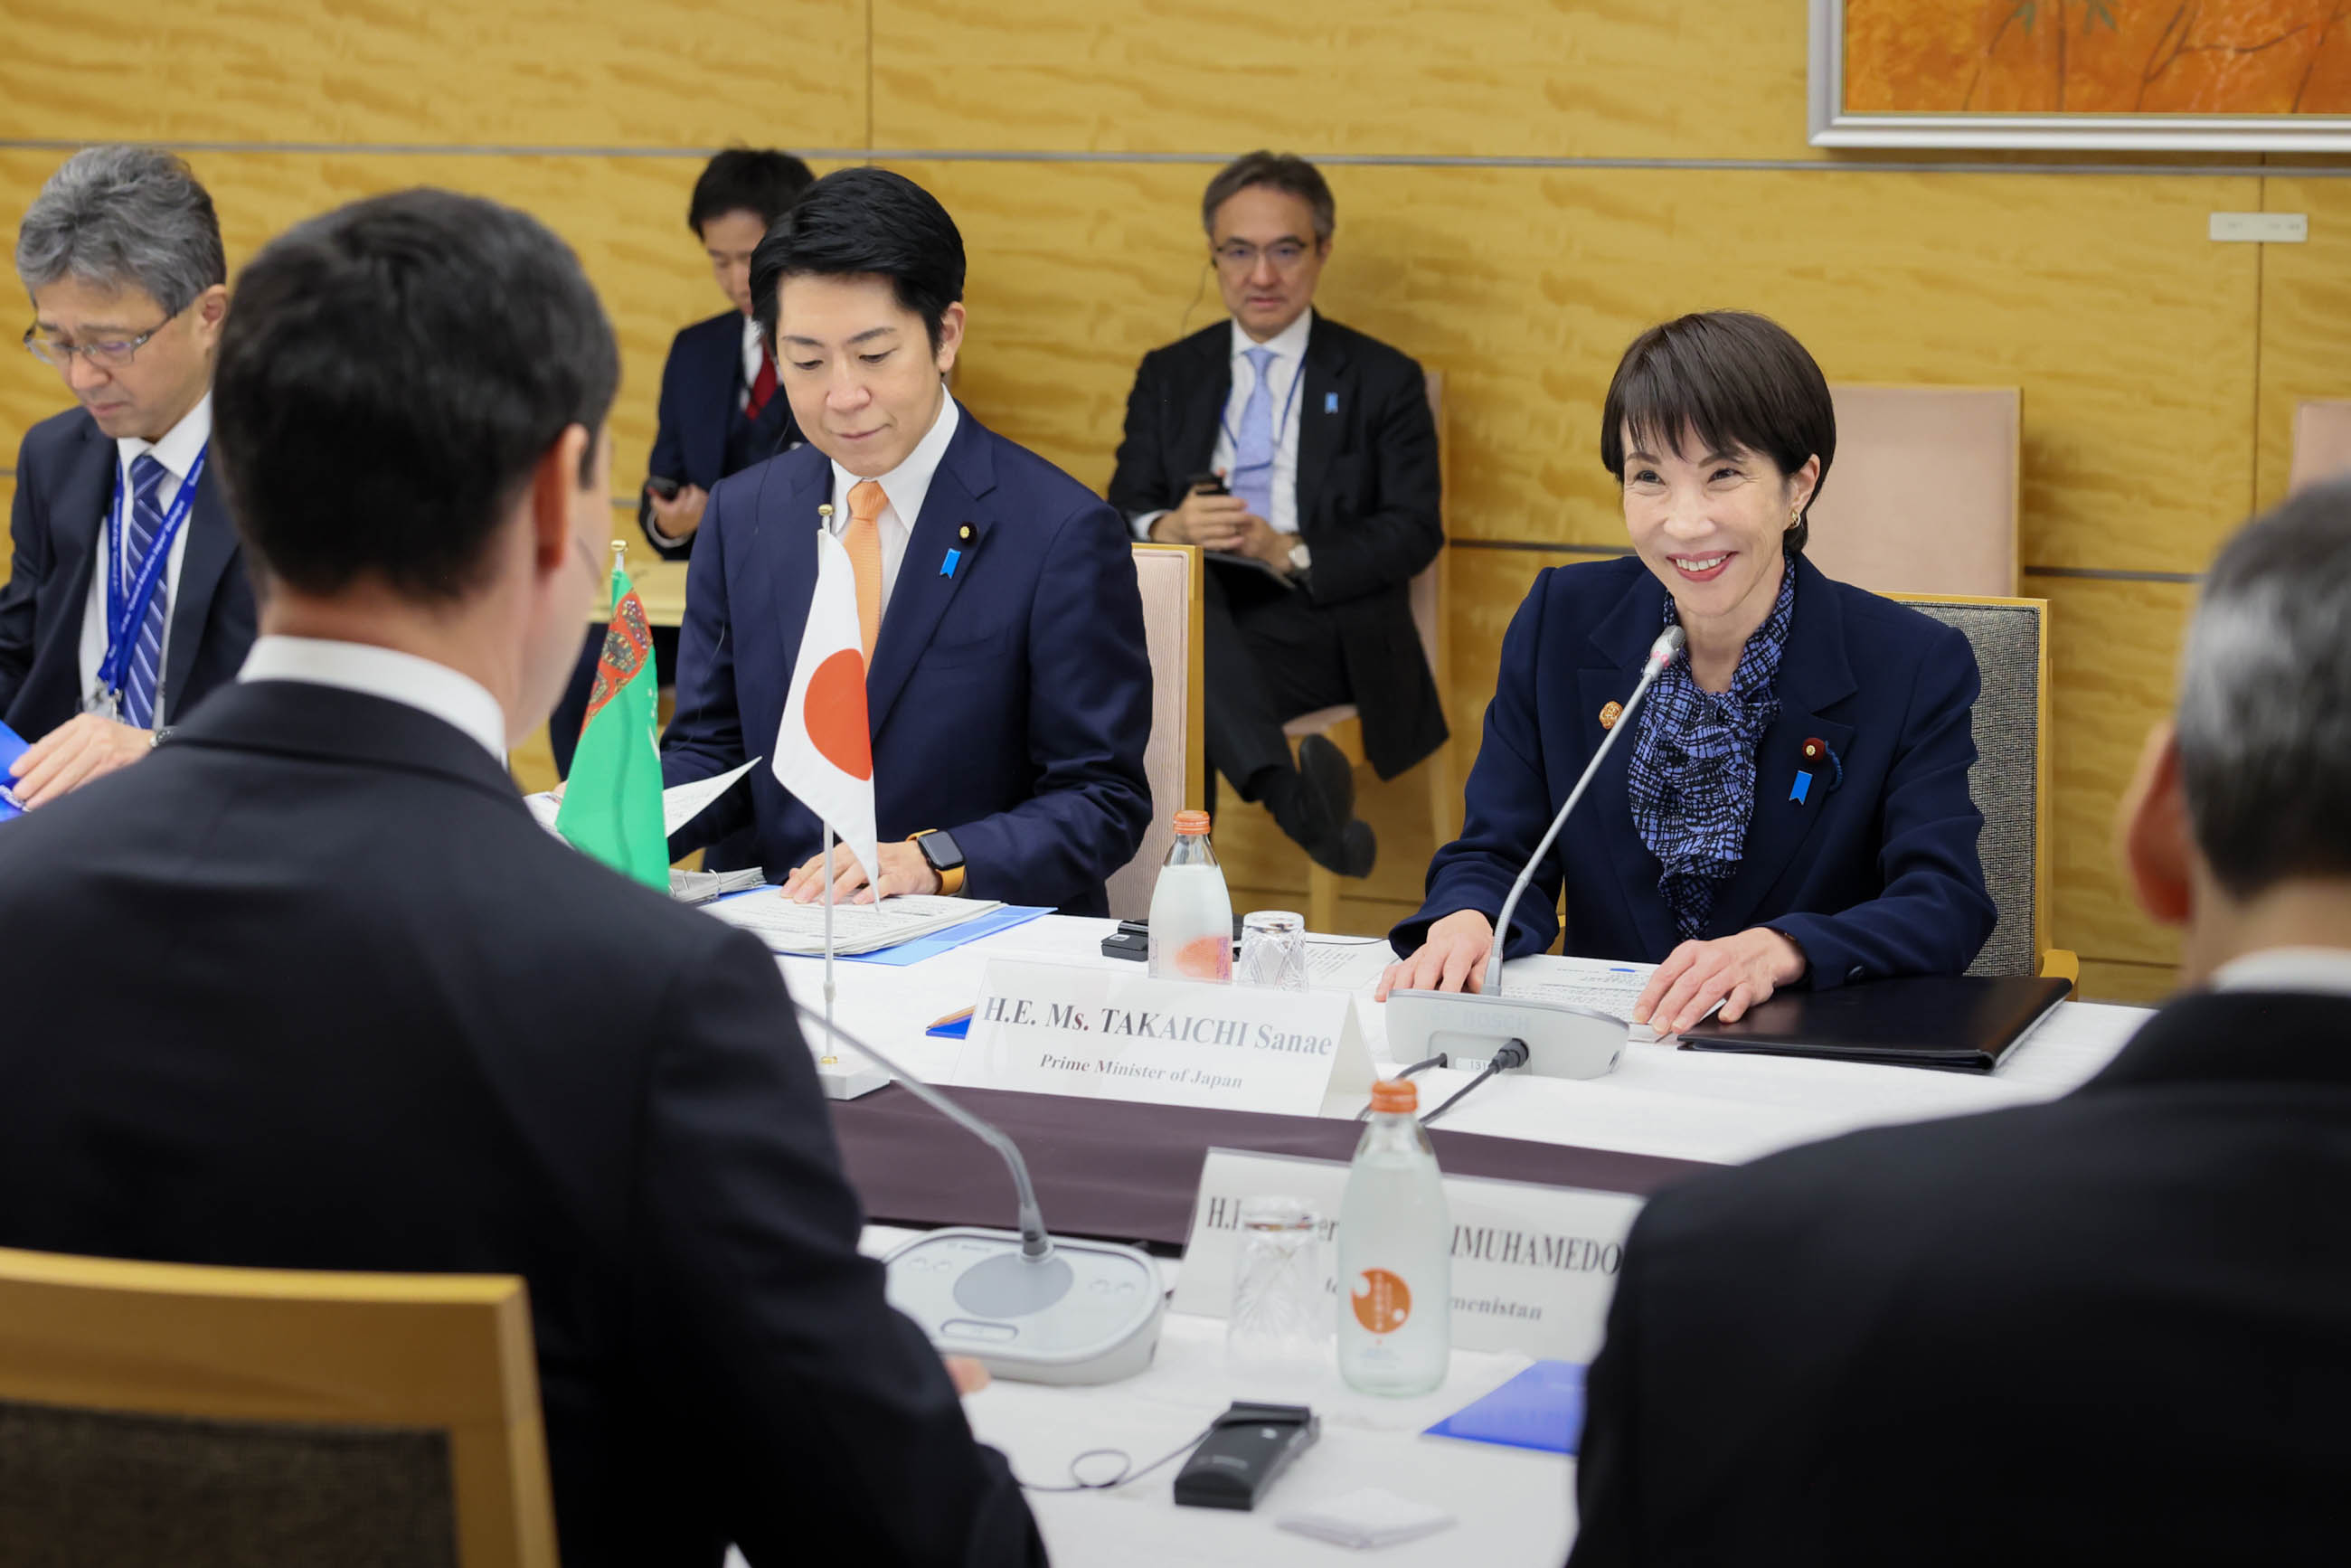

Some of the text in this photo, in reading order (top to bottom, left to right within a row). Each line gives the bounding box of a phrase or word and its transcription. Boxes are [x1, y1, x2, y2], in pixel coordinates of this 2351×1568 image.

[983, 997, 1333, 1055] H.E. Ms. TAKAICHI Sanae
[1040, 1053, 1243, 1089] Prime Minister of Japan
[1449, 1225, 1623, 1276] IMUHAMEDO
